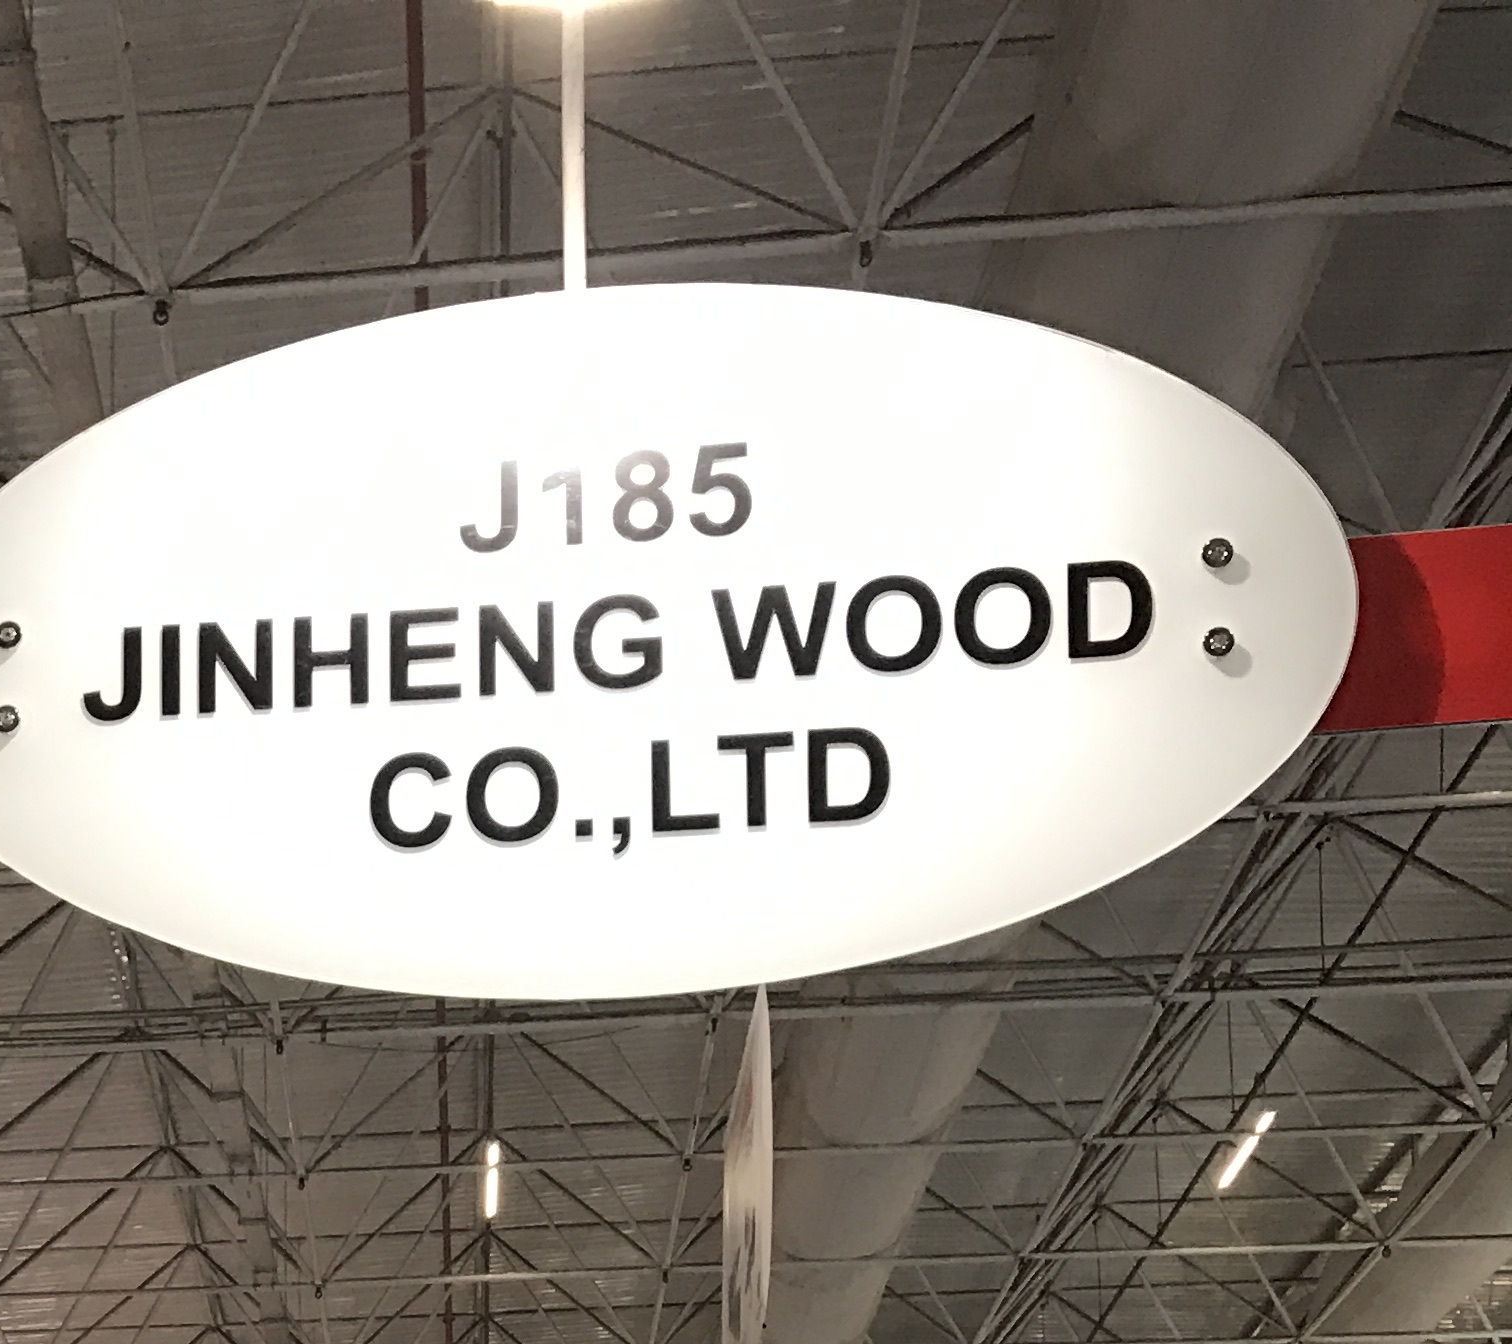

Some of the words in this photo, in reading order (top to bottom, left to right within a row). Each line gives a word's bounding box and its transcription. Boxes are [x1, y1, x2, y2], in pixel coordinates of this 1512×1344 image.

[460, 442, 753, 554] J185
[84, 593, 665, 725] JINHENG
[712, 560, 1155, 683] WOOD
[368, 725, 892, 856] CO.,LTD
